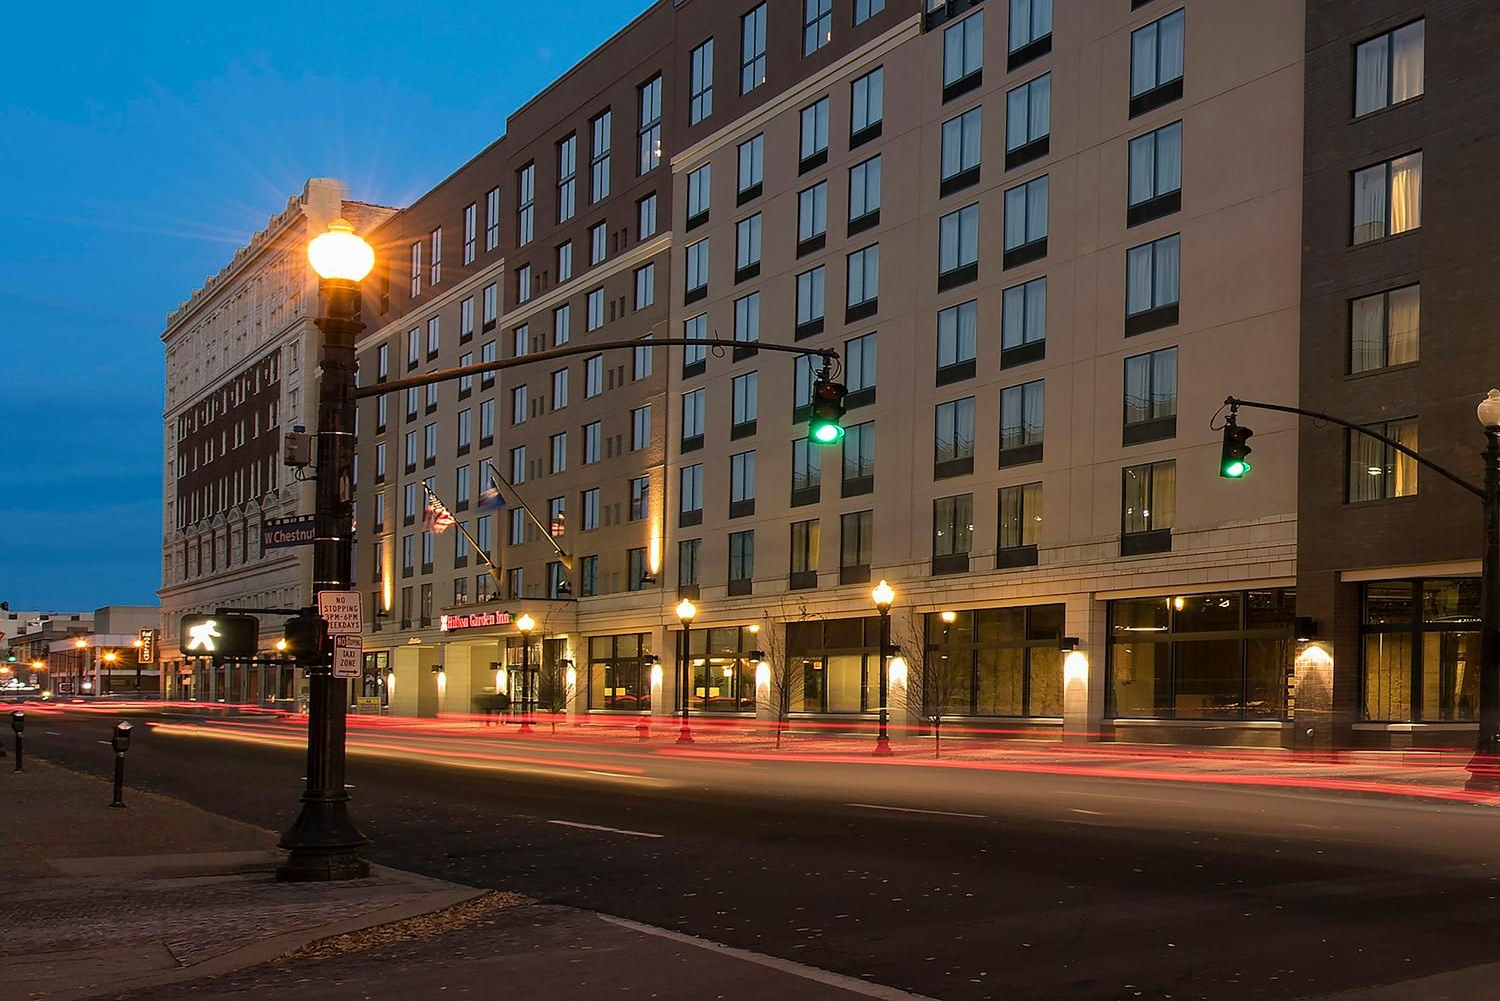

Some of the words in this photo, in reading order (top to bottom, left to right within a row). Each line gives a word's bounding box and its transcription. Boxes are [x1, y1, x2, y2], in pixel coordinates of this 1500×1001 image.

[264, 531, 273, 544] W
[273, 527, 316, 544] Chestnut
[335, 596, 346, 604] NO
[324, 605, 358, 613] STOPPING
[447, 615, 469, 629] Hilton
[469, 612, 495, 627] Garden
[496, 610, 510, 624] Inn
[328, 621, 360, 629] EEKDAYS
[336, 637, 346, 646] NO
[343, 650, 356, 658] TAXI
[340, 659, 356, 667] ZONE
